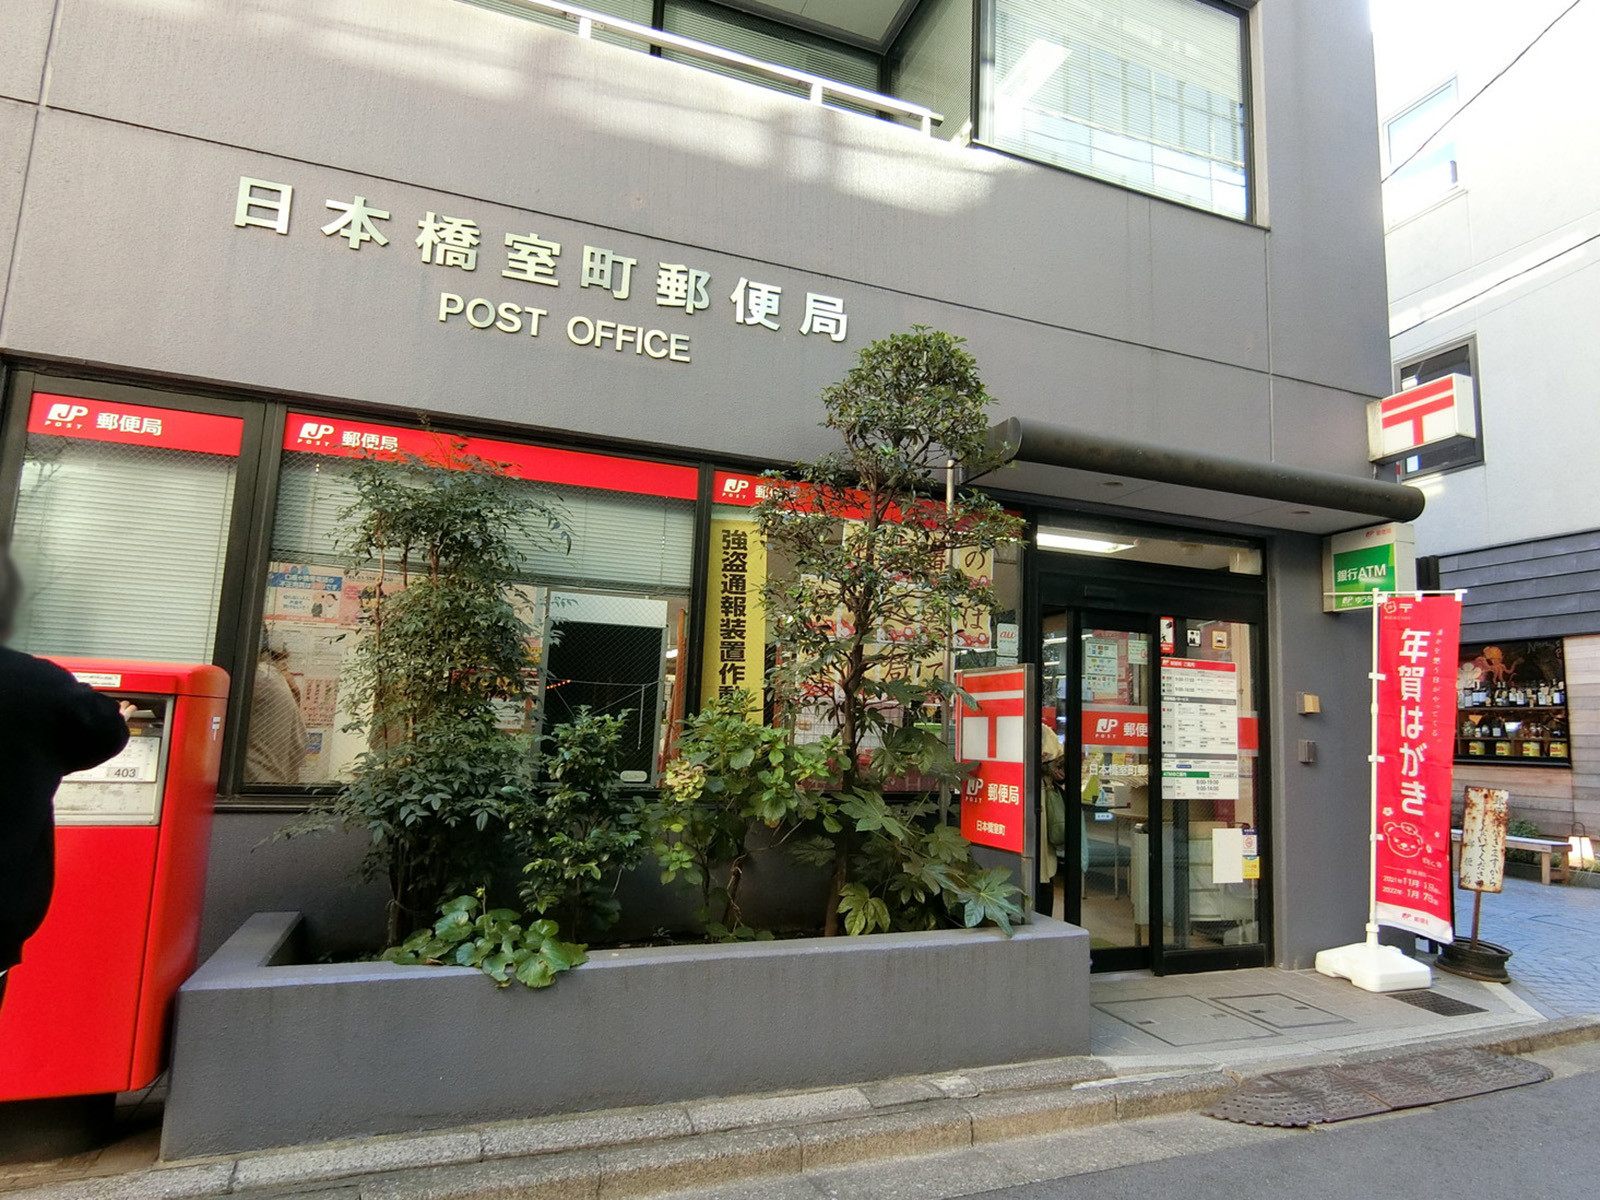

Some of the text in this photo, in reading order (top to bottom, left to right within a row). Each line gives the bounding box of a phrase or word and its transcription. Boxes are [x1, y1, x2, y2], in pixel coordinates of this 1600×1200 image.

[234, 175, 848, 342] 日本橋室町郵便局
[438, 292, 691, 363] POST OFFICE
[45, 420, 83, 430] POST
[47, 403, 162, 436] JP 郵便局
[297, 438, 330, 447] POST
[299, 422, 399, 453] JP 郵便局
[1336, 563, 1387, 583] 銀行ATM
[999, 631, 1016, 639] au
[1096, 718, 1119, 733] JP
[1397, 627, 1432, 817] 年賀はがき
[114, 768, 136, 778] 403
[987, 783, 1019, 806] 郵便局
